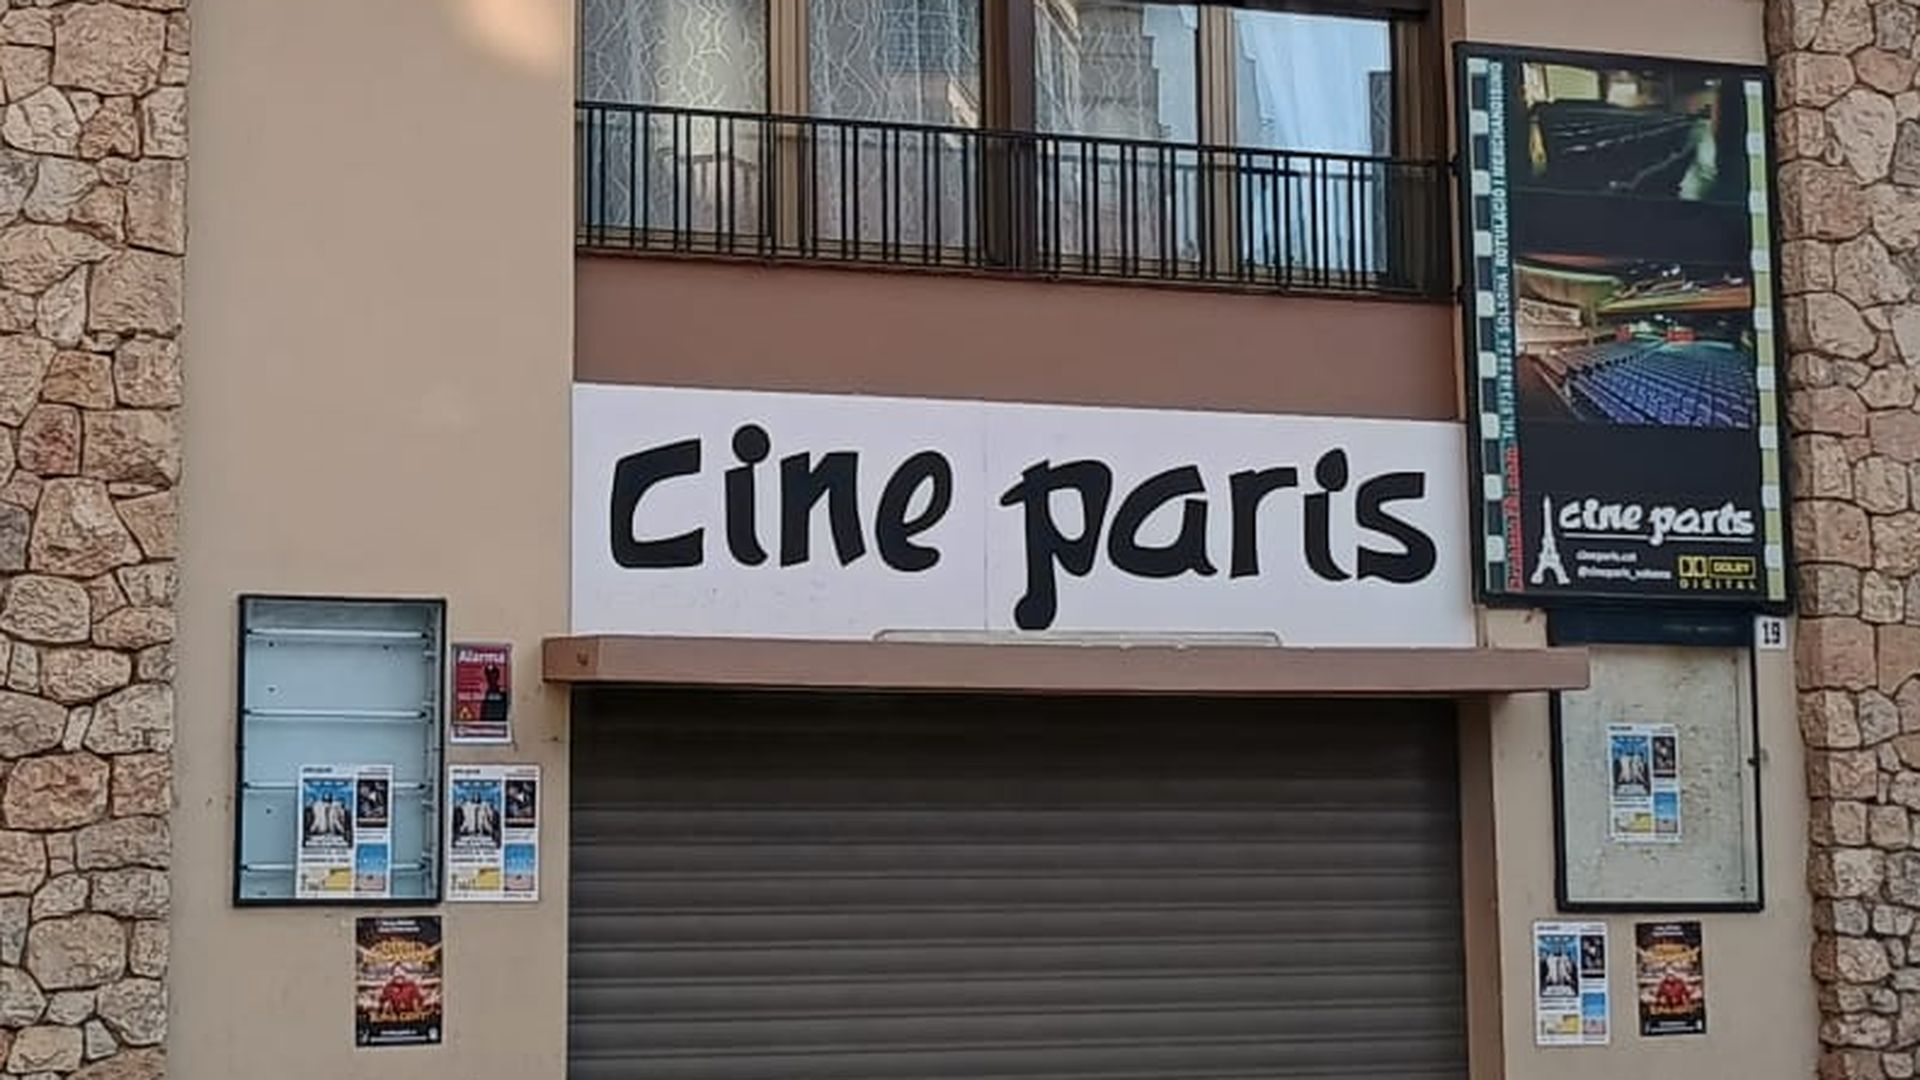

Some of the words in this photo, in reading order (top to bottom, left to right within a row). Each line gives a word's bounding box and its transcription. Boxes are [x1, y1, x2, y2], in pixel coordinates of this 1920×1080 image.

[610, 424, 953, 573] cine
[1000, 447, 1438, 631] paris
[1558, 498, 1643, 531] cine
[1648, 501, 1756, 546] paris
[1679, 578, 1756, 590] DIGITAL
[1762, 621, 1781, 645] 19
